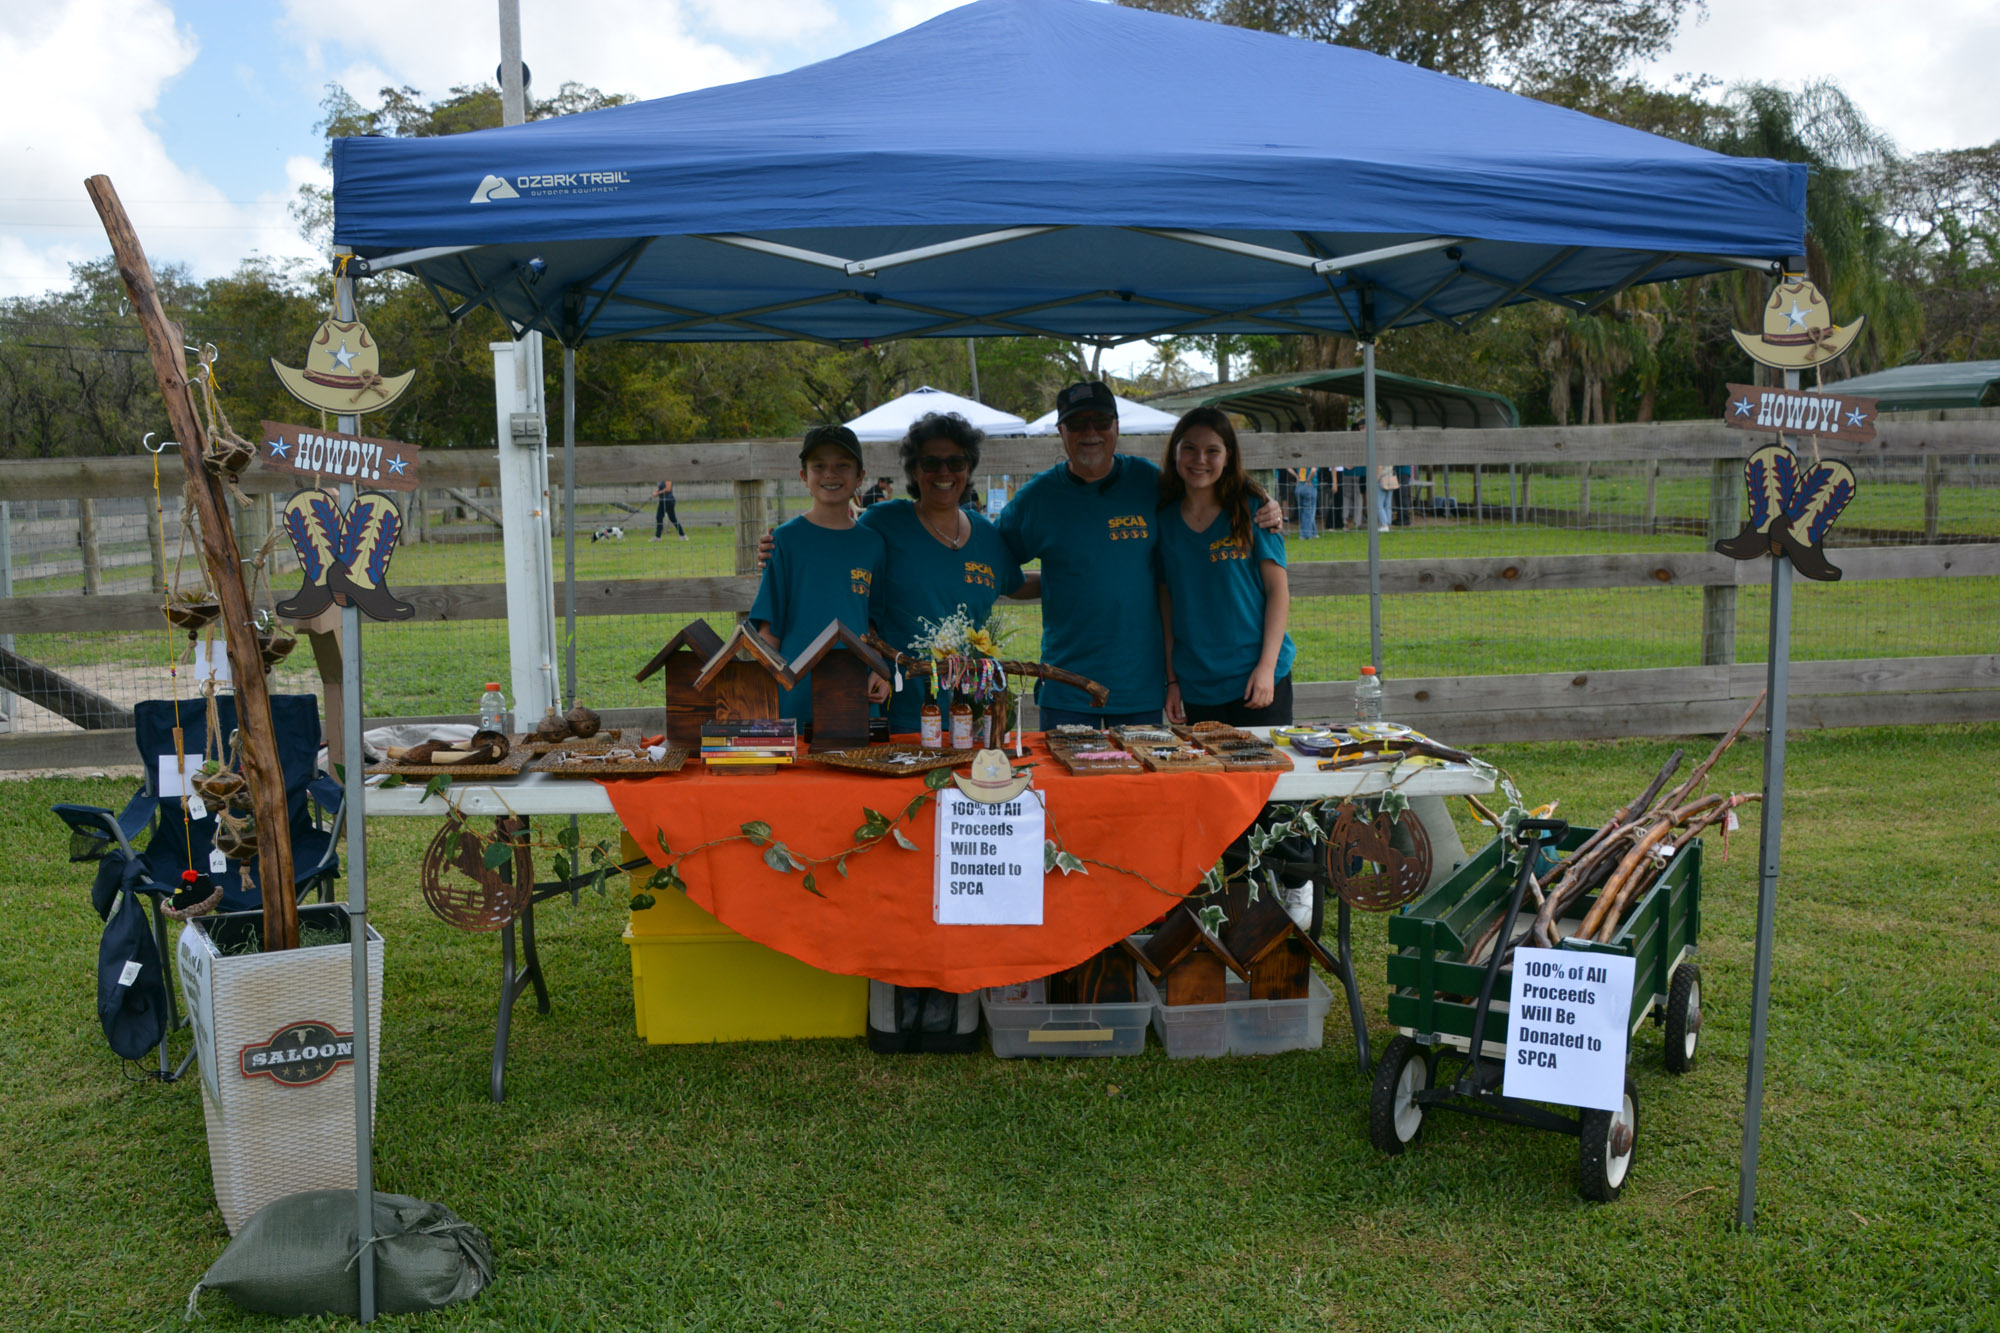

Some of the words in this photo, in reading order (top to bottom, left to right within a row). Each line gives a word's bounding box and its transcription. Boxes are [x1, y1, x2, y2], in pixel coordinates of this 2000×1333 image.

[517, 173, 578, 189] OZARK
[579, 171, 631, 185] TRAIL
[572, 186, 619, 194] EQUIPMENT
[1757, 392, 1842, 433] HOWDY!
[294, 433, 383, 480] HOWDY!
[1108, 516, 1139, 528] SPCA
[965, 561, 989, 575] SPCA
[951, 801, 986, 816] 100%
[989, 803, 1001, 816] of
[1004, 802, 1022, 816] All
[951, 822, 1014, 836] Proceeds
[951, 841, 977, 856] Will
[980, 842, 997, 856] Be
[951, 862, 1006, 876] Donated
[1009, 863, 1022, 876] to
[950, 881, 984, 895] SPCA
[1525, 961, 1565, 979] 100%
[1568, 966, 1584, 981] of
[1586, 967, 1607, 984] All
[1523, 983, 1596, 1005] Proceeds
[1521, 1004, 1552, 1022] Will
[1555, 1008, 1576, 1025] Be
[1519, 1027, 1584, 1050] Donated
[1587, 1036, 1602, 1052] to
[252, 1042, 354, 1067] SALOON
[1517, 1049, 1557, 1069] SPCA
